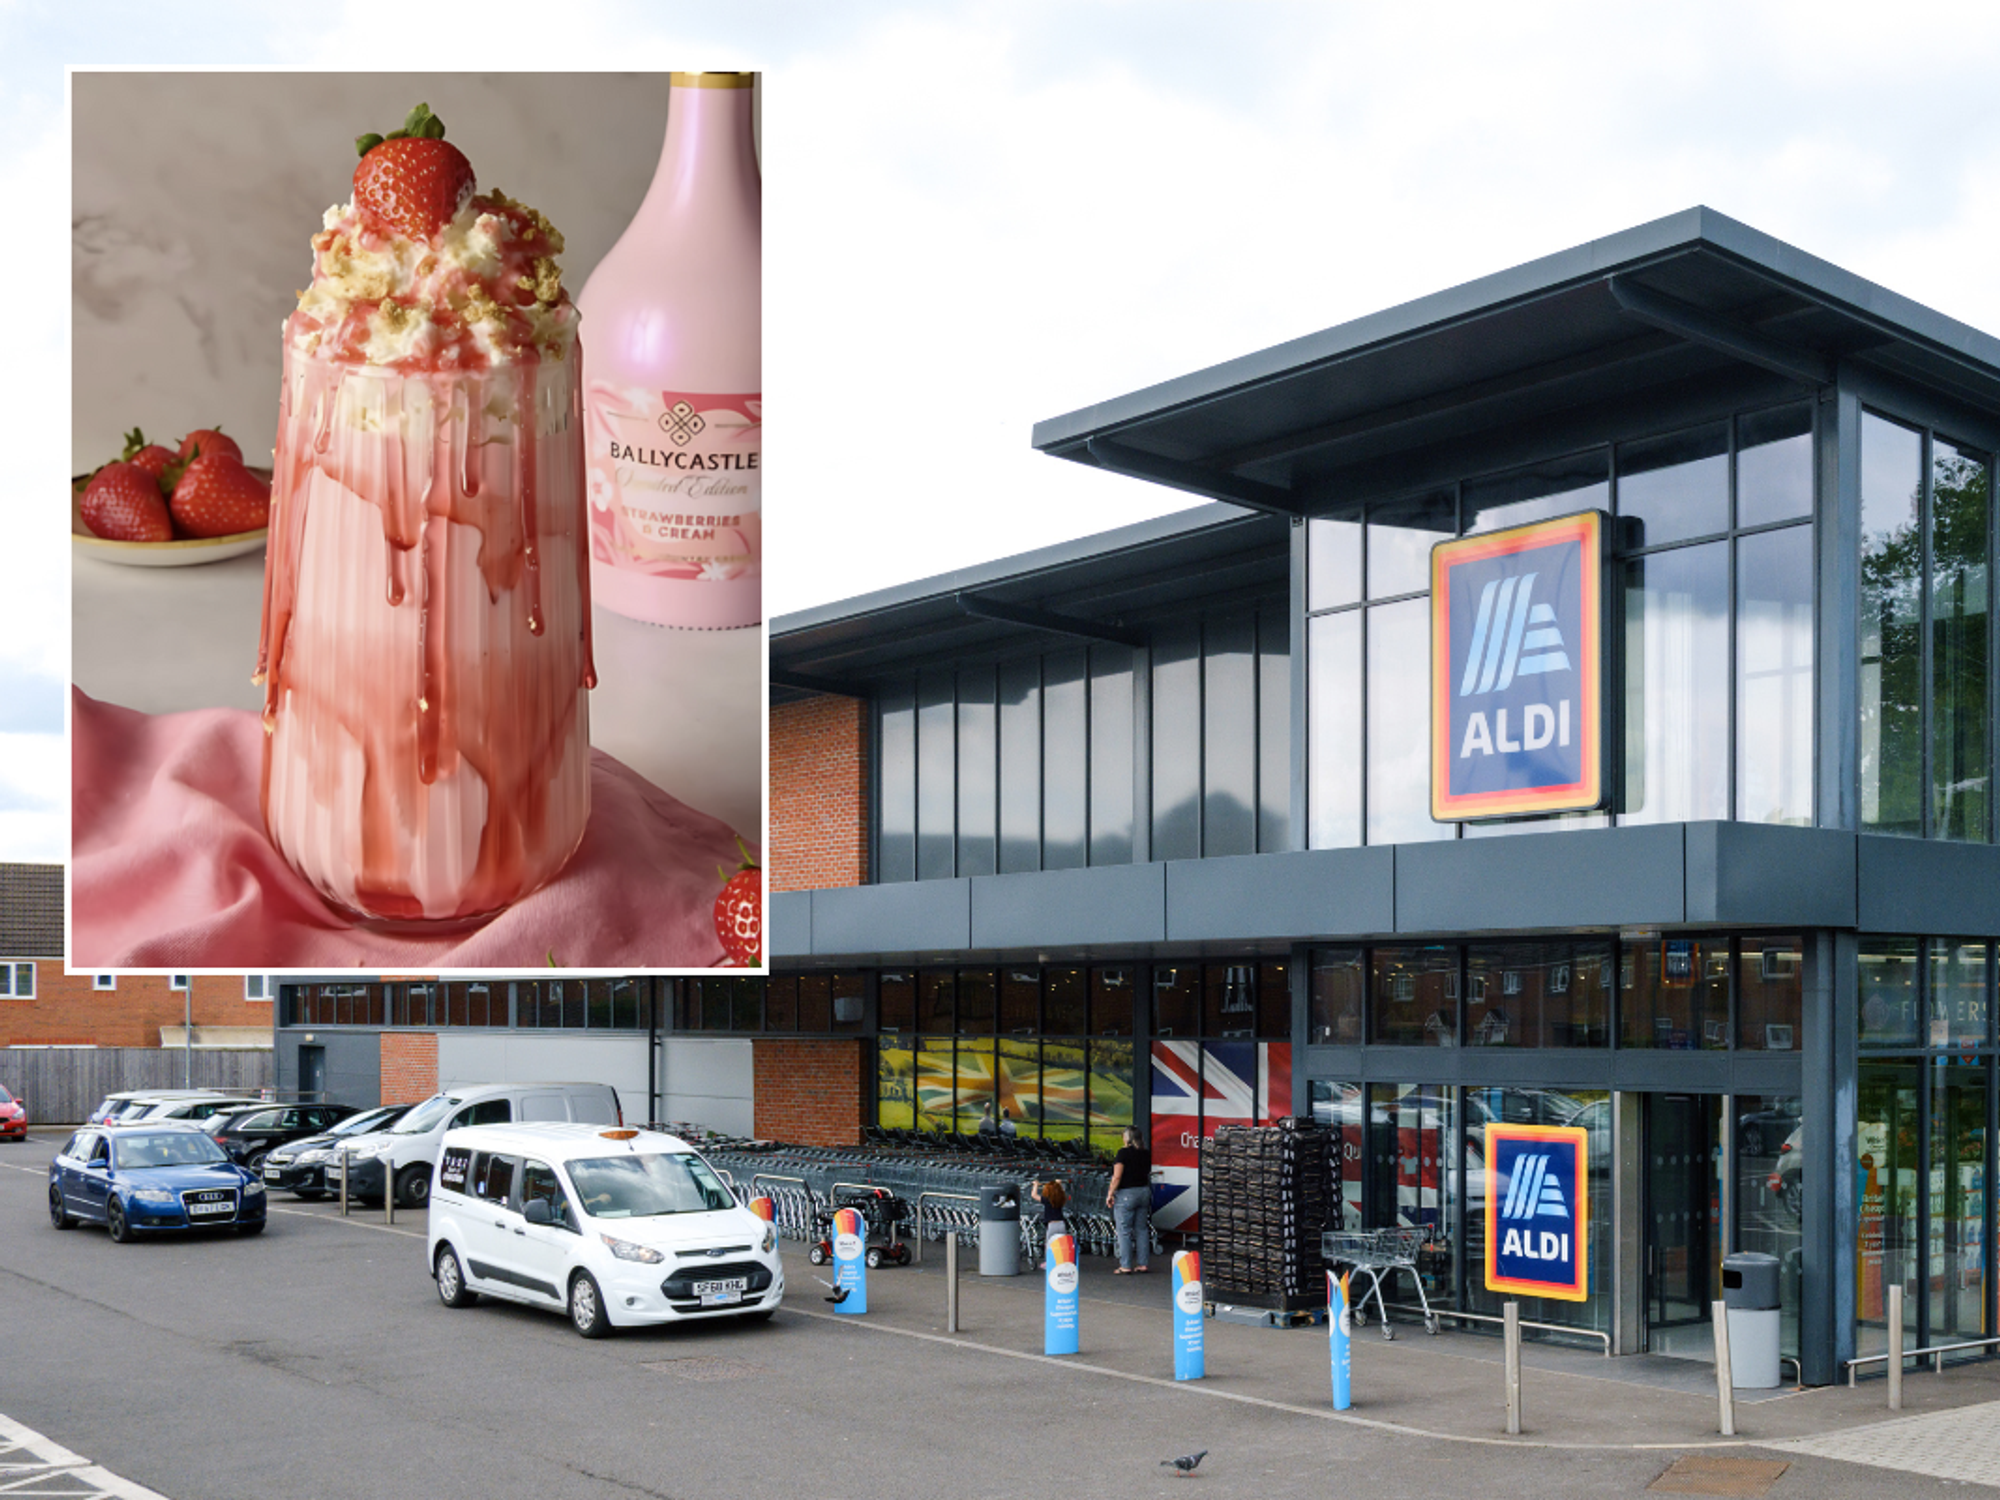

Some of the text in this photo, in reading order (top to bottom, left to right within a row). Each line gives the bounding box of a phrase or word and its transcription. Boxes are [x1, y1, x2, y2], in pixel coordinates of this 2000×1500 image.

[611, 441, 759, 470] BALLYCASTLE
[621, 505, 741, 527] STRAWBERRIES
[658, 526, 715, 541] CREAM
[1460, 699, 1570, 758] ALDI
[1902, 1000, 1987, 1022] FLWER
[1501, 1227, 1568, 1262] ALDI
